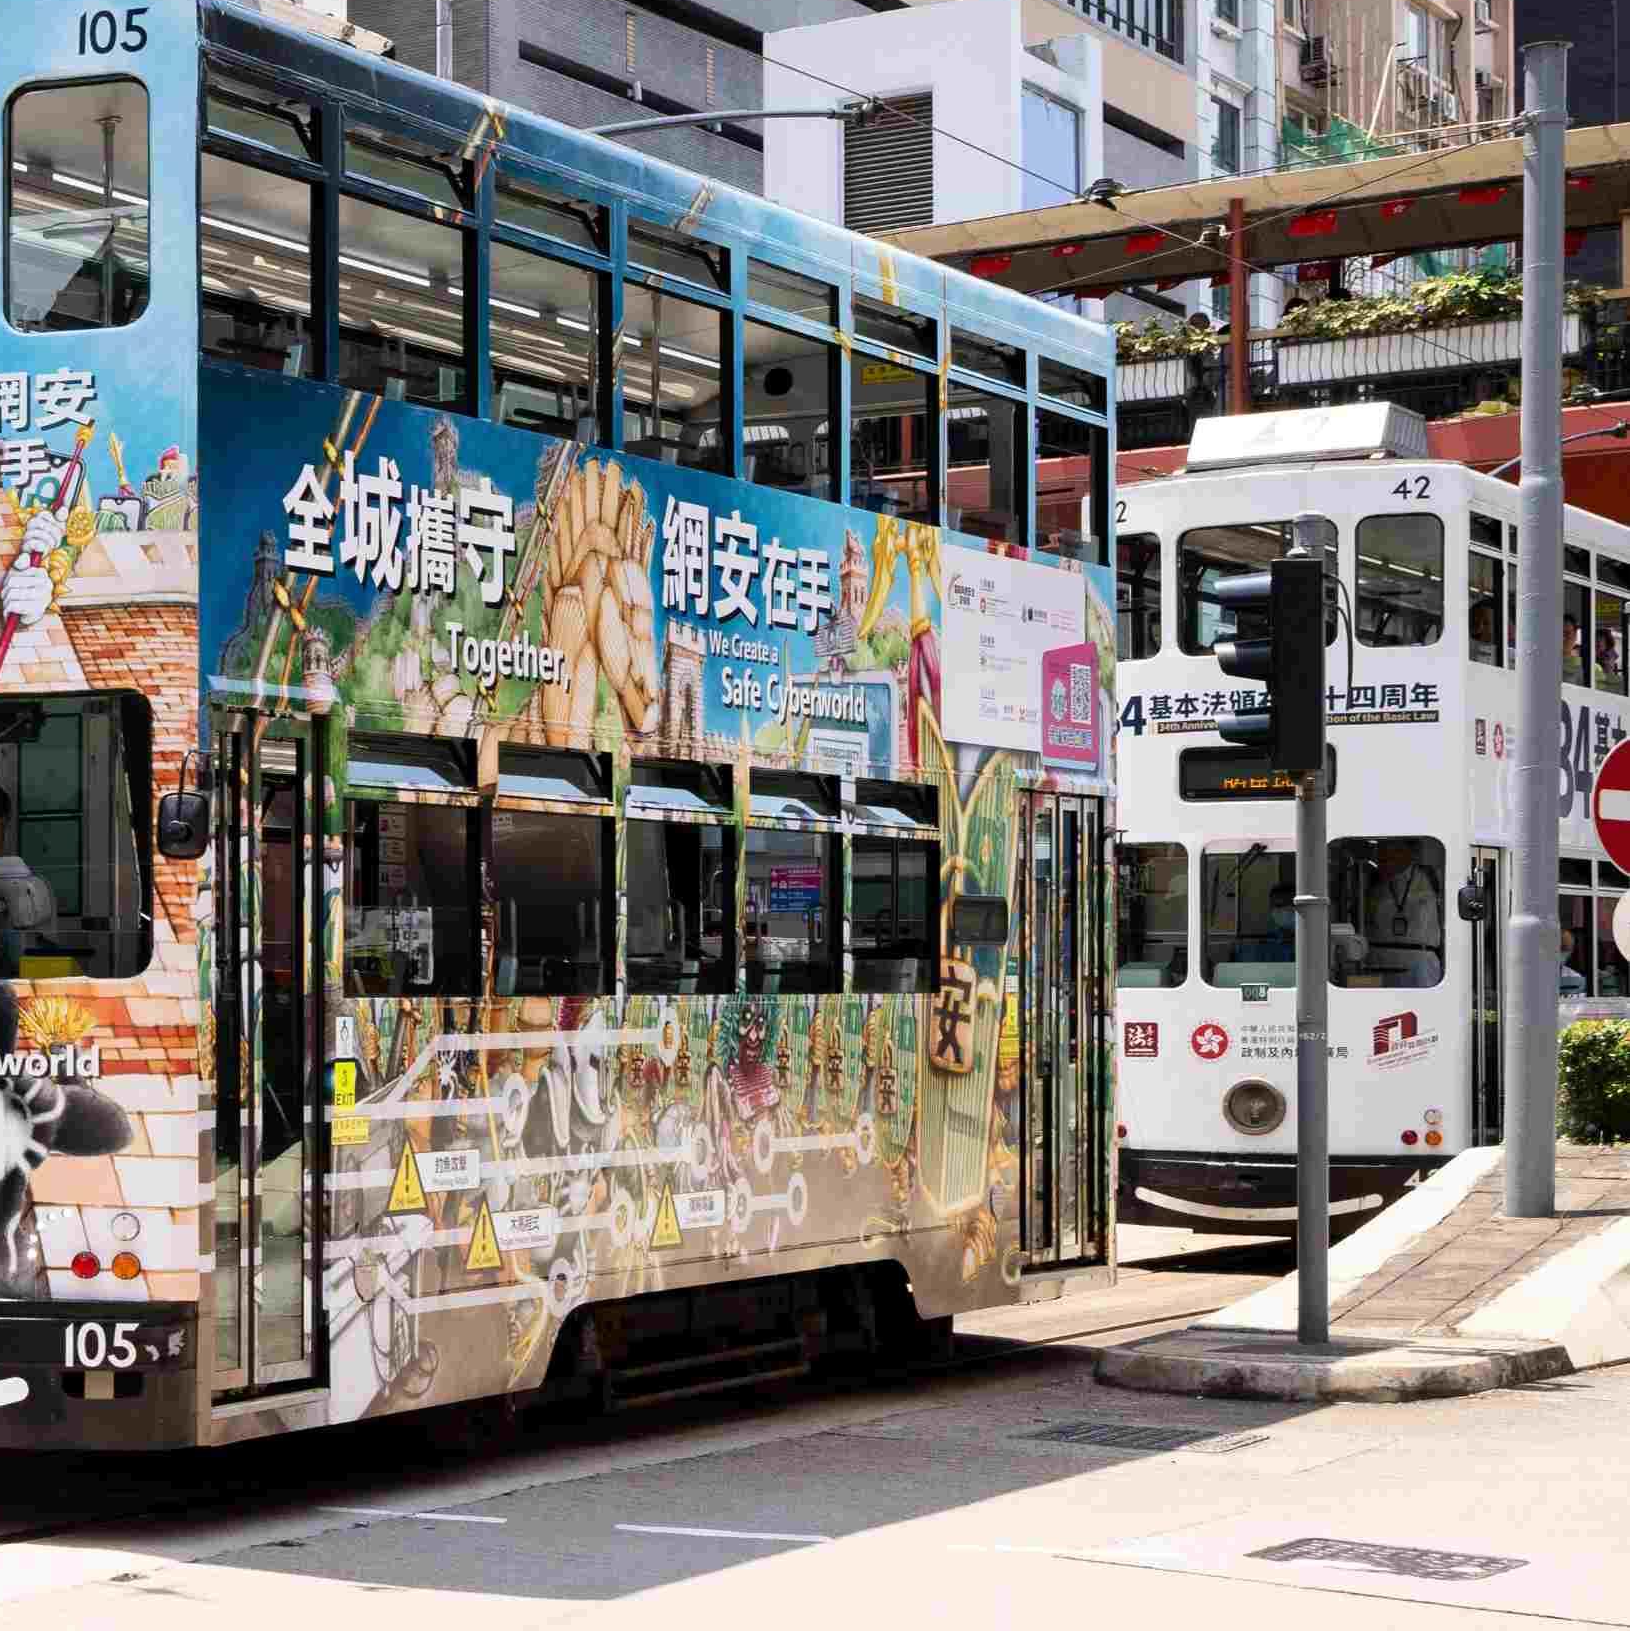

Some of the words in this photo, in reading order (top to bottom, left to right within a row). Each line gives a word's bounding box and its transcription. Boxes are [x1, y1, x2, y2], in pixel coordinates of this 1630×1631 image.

[77, 8, 148, 56] 105
[1391, 475, 1431, 501] 42
[1116, 500, 1127, 523] 2
[445, 621, 571, 693] Together,
[708, 630, 730, 655] We
[732, 637, 770, 663] Create
[721, 668, 763, 709] Safe
[768, 674, 867, 727] Cyberworld
[336, 1093, 355, 1106] EXIT
[63, 1322, 138, 1369] 105
